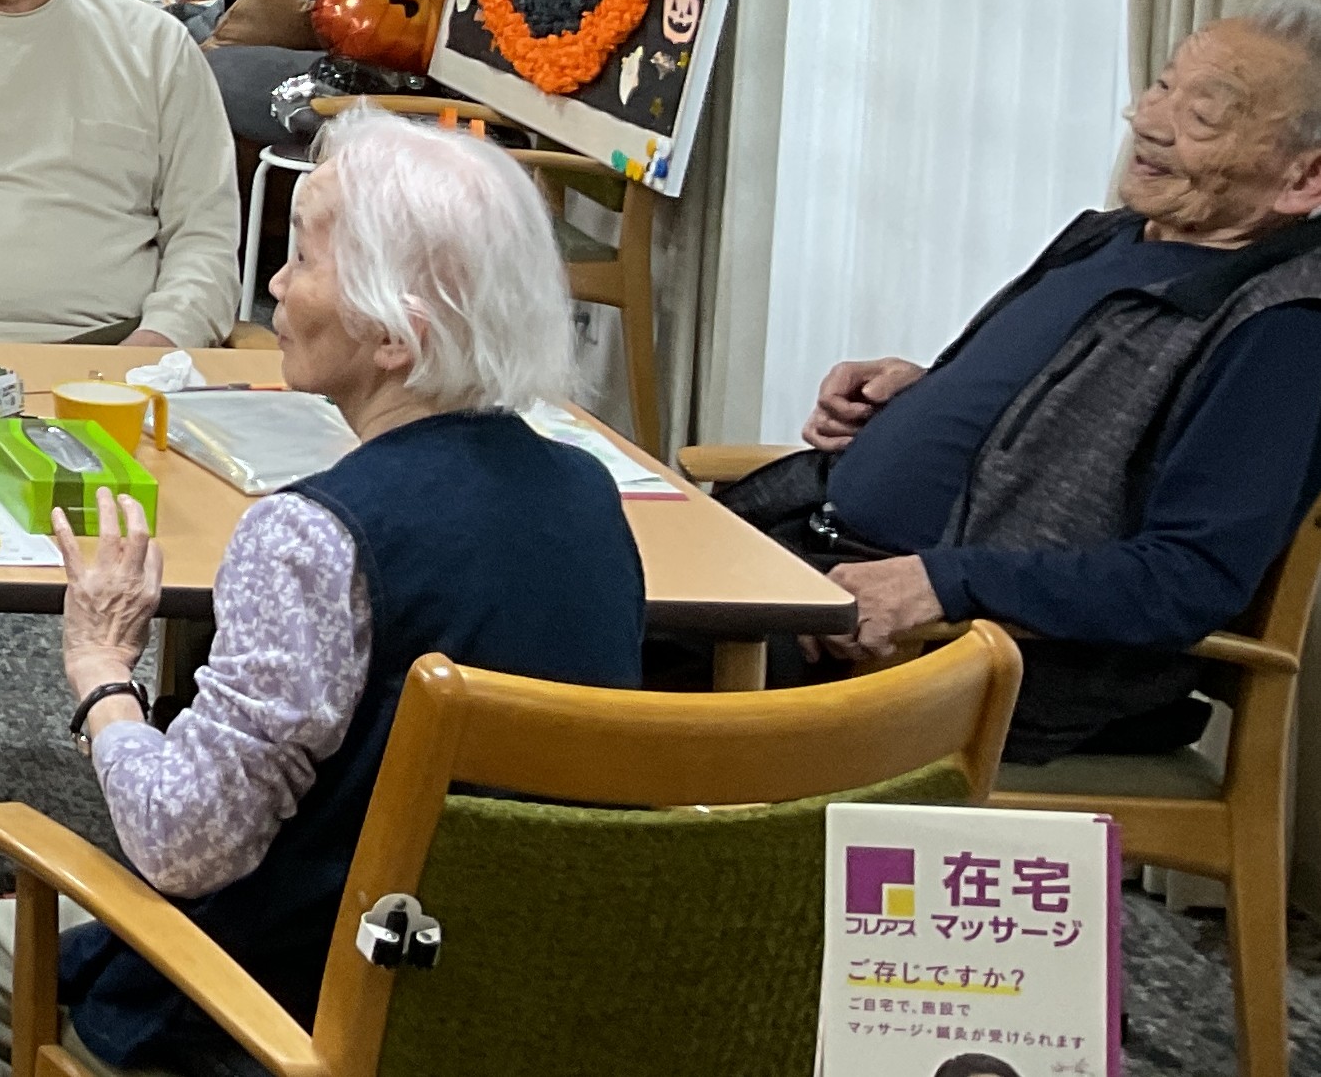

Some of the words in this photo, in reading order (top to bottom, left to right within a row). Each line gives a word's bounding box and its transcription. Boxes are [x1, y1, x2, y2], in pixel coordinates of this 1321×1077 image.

[942, 851, 1071, 913] 在宅
[845, 916, 917, 937] フレアス
[930, 913, 1083, 947] マッサージ
[847, 959, 1026, 992] ご存じですか?
[848, 996, 971, 1017] ご自宅で、施設で
